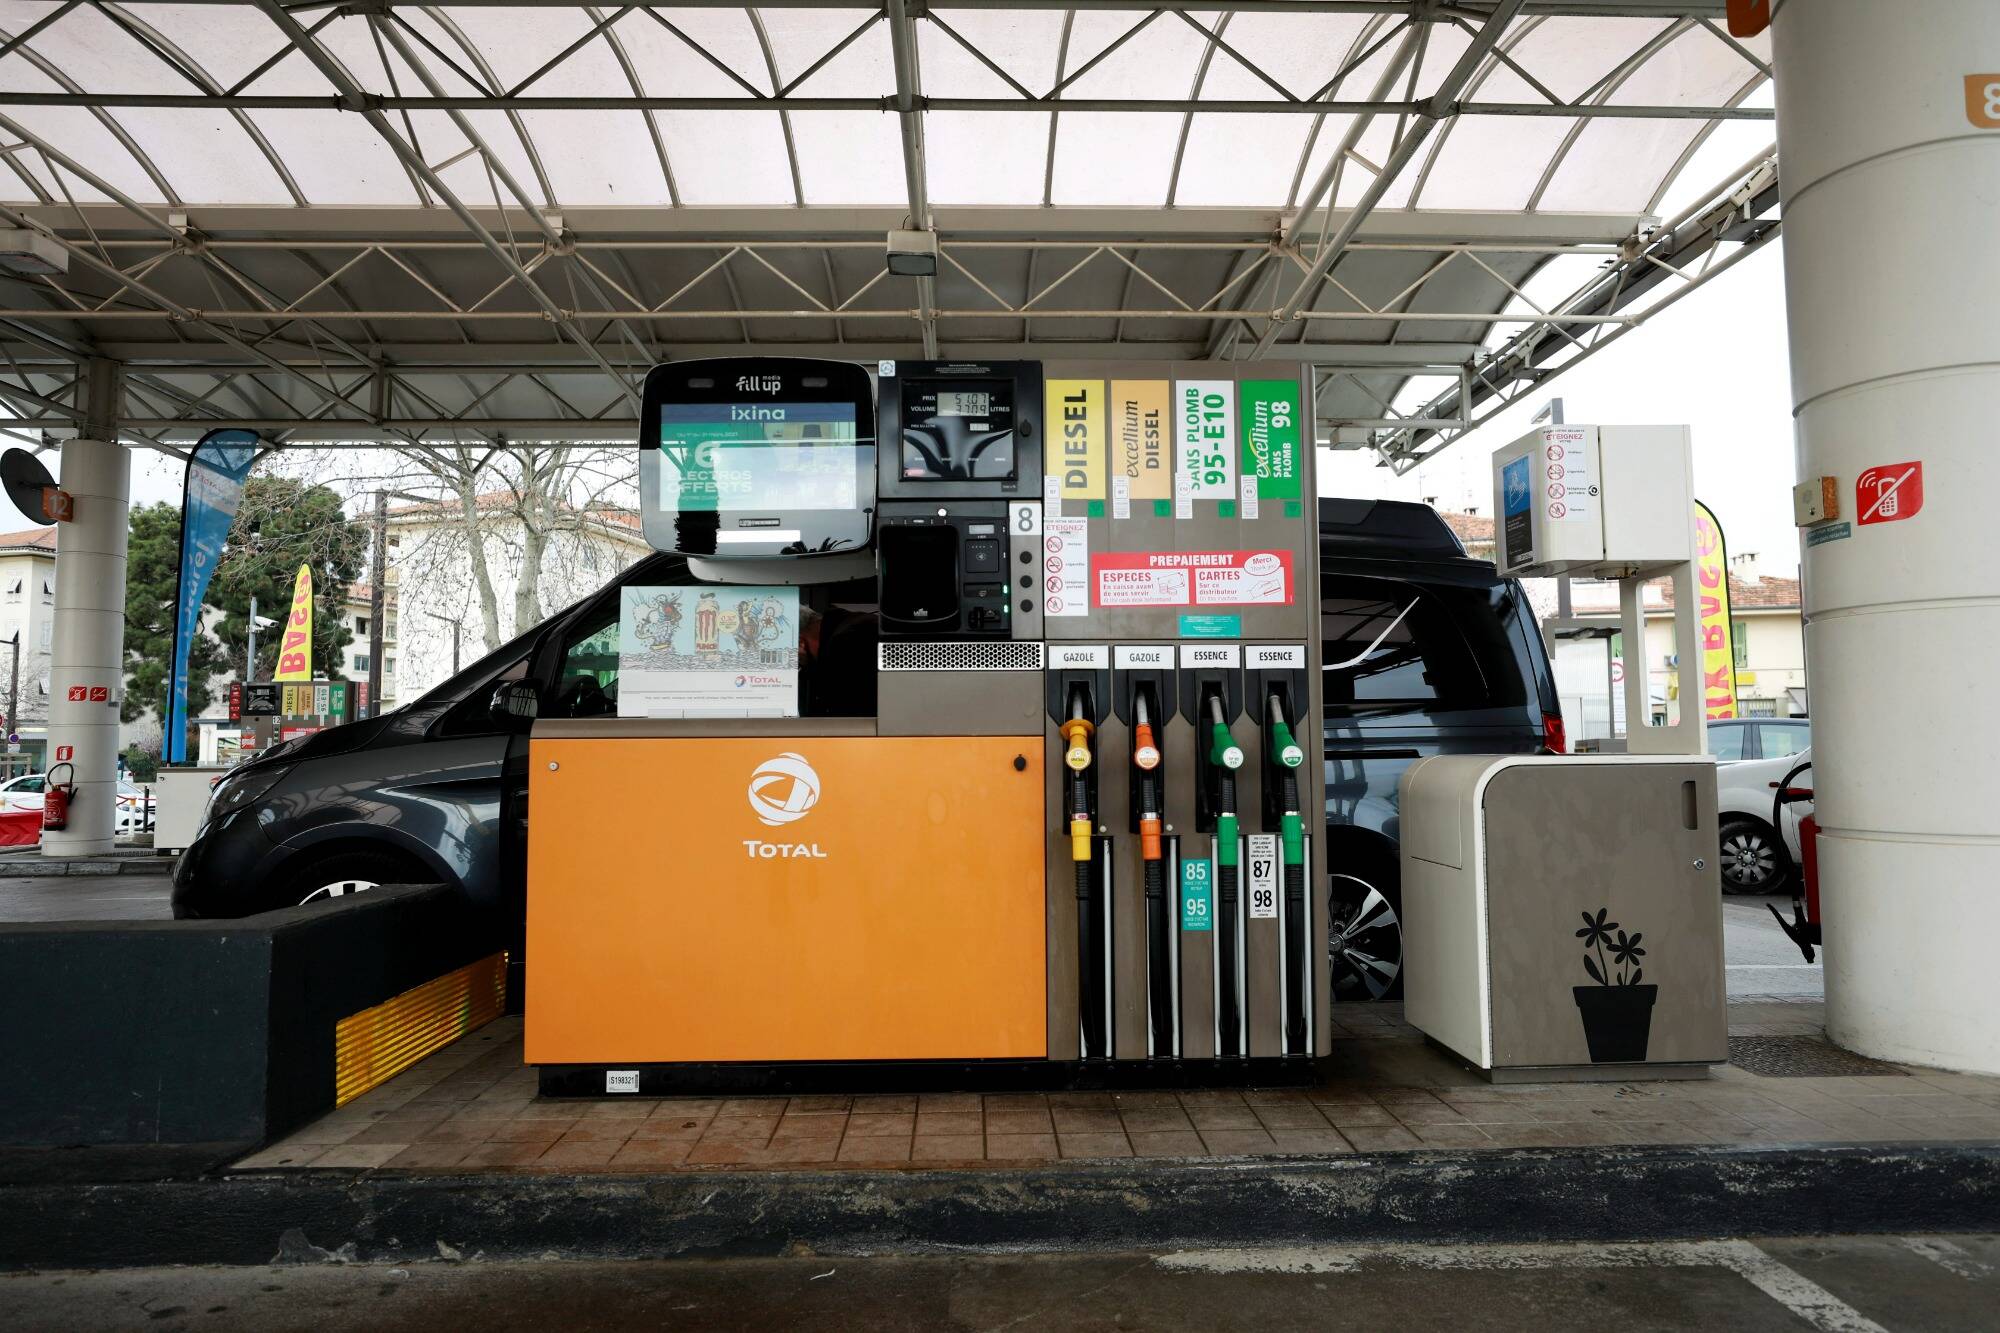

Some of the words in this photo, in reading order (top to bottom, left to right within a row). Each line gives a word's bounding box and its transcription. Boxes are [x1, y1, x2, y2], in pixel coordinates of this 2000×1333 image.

[735, 375, 760, 391] fill
[762, 381, 781, 395] up
[731, 406, 785, 421] ixina
[1185, 387, 1200, 443] PLOMB
[1271, 399, 1291, 428] 98
[1064, 388, 1088, 489] DIESEL
[1121, 399, 1139, 478] excellium
[1145, 408, 1160, 469] DIESEL
[1203, 393, 1226, 485] 95-E10
[1254, 399, 1271, 479] excellium
[1273, 450, 1282, 478] SANS
[1284, 441, 1292, 478] PLOMB
[1186, 448, 1201, 491] SANS
[667, 481, 753, 493] OFFERTS
[1018, 507, 1033, 532] 8
[1149, 554, 1233, 567] PREPAIEMENT
[1252, 556, 1272, 565] Merci
[1103, 572, 1152, 582] ESPECES
[1199, 571, 1240, 581] CARTES
[1063, 652, 1094, 662] GAZOLE
[1129, 652, 1160, 662] GAZOLE
[1194, 651, 1228, 661] ESSENCE
[1259, 651, 1293, 661] ESSENCE
[748, 675, 781, 684] TOTAL
[273, 716, 280, 724] 12
[743, 840, 827, 858] TOTAL
[1186, 863, 1206, 880] 85
[1253, 860, 1271, 878] 87
[1186, 898, 1206, 916] 95
[1254, 890, 1272, 907] 98
